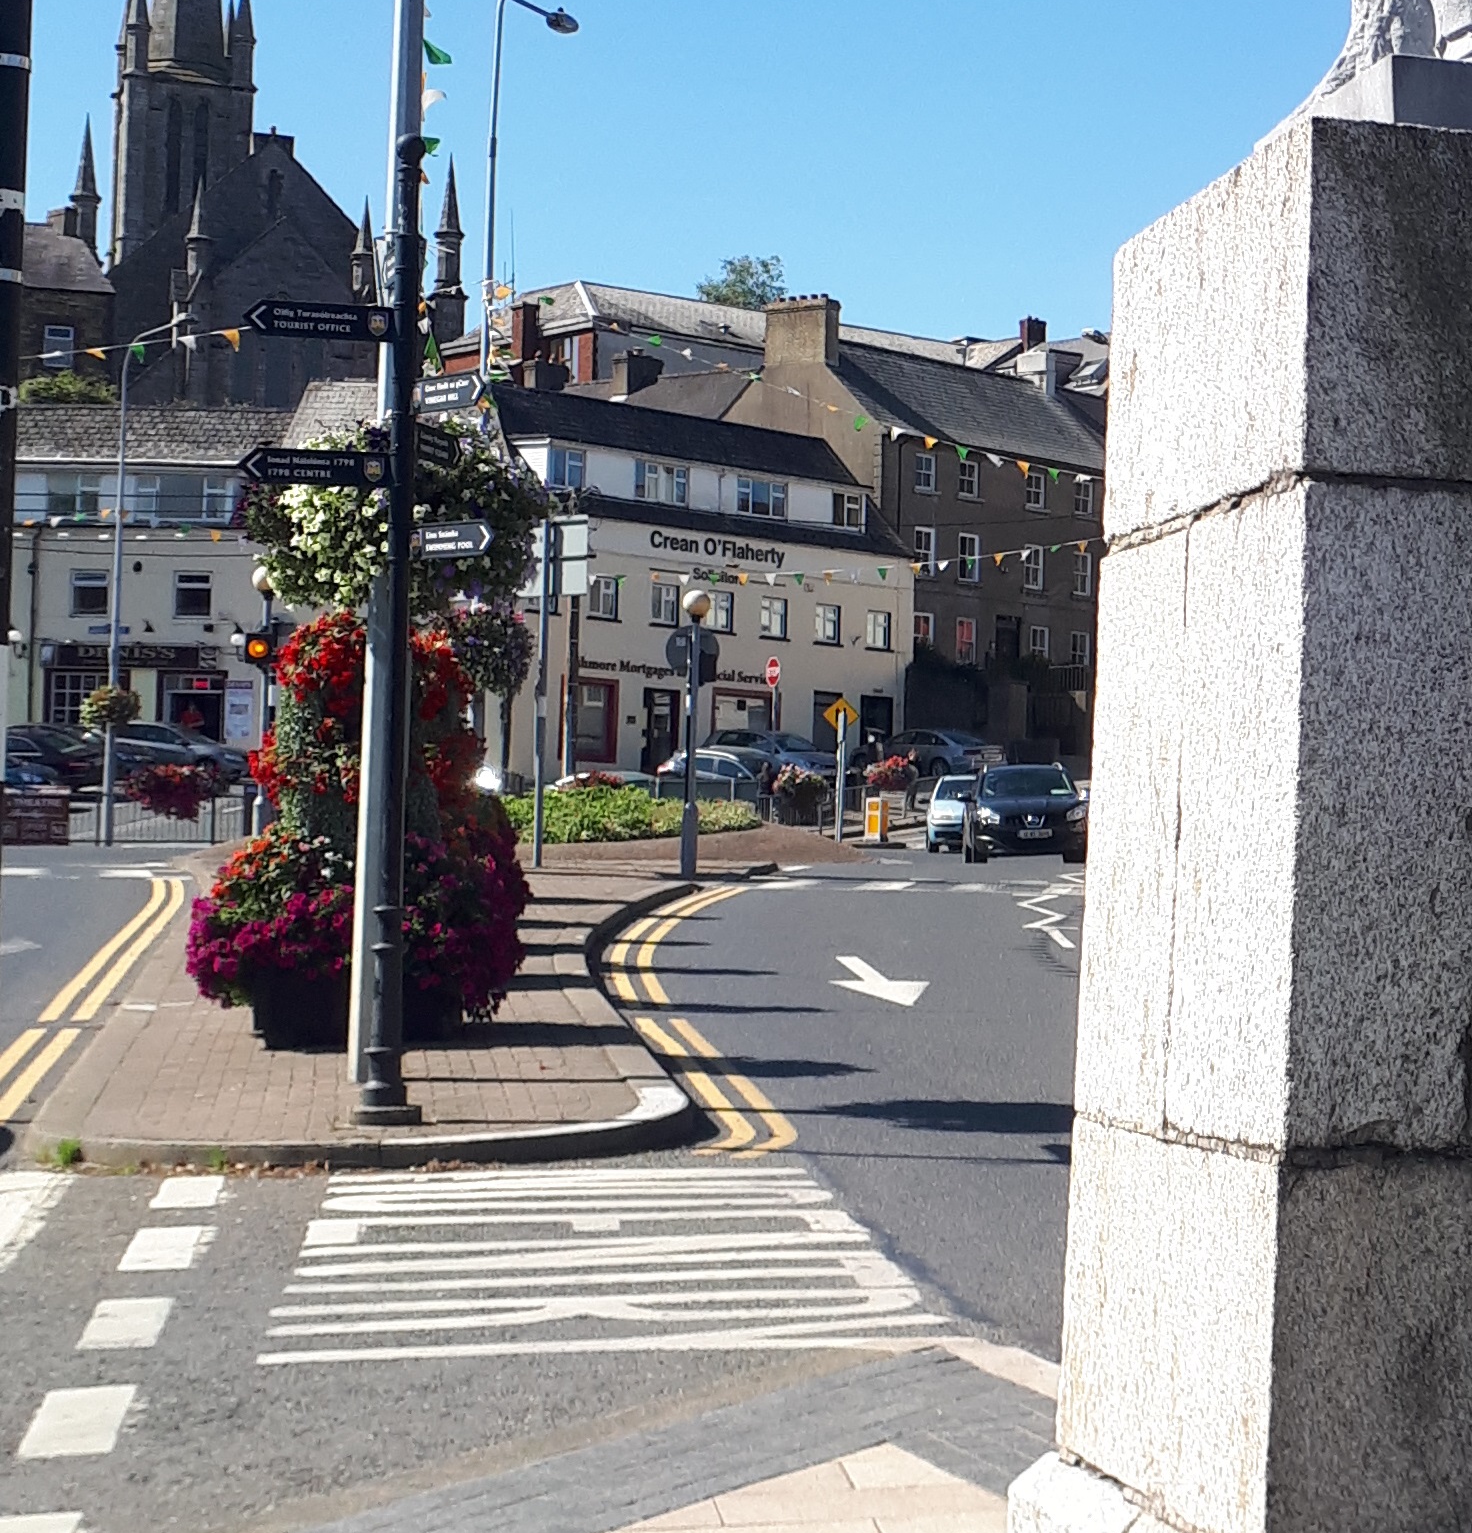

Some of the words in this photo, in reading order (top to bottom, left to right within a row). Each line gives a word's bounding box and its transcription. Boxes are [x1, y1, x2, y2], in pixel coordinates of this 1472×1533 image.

[273, 320, 315, 330] TOURIST
[318, 323, 351, 332] OFFICE
[334, 457, 355, 466] 1798
[267, 467, 290, 477] 1798
[293, 468, 331, 478] CENTRE
[650, 530, 699, 554] Crean
[703, 537, 786, 569] O'Flaherty
[579, 655, 617, 672] hmore
[619, 660, 675, 680] Mortgages
